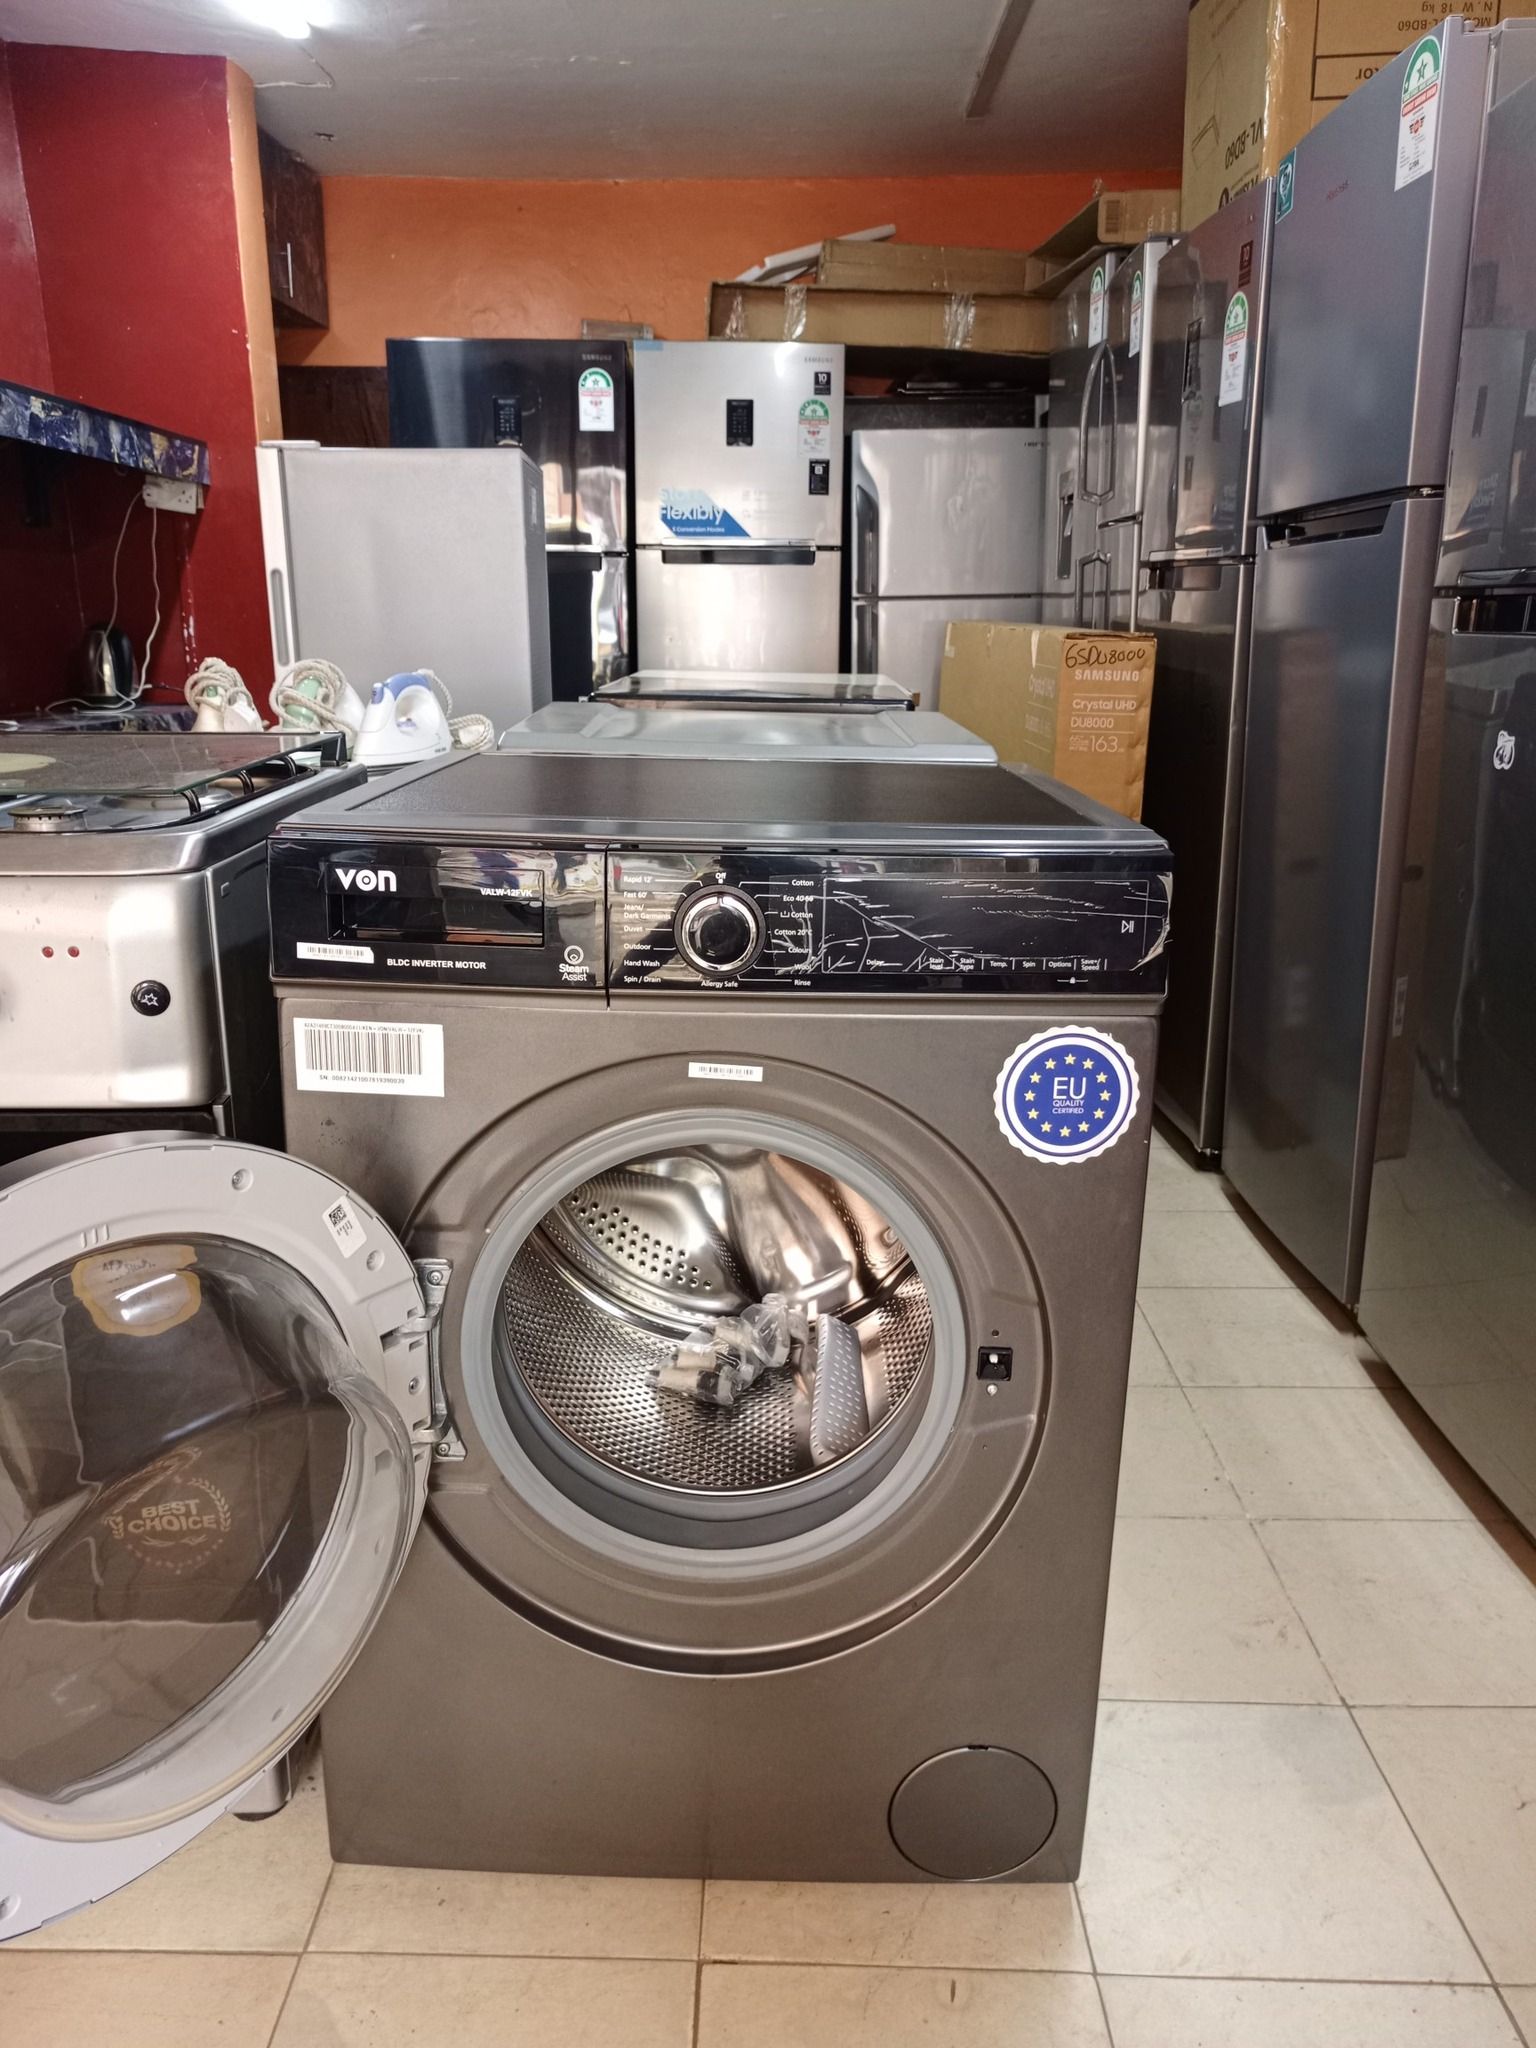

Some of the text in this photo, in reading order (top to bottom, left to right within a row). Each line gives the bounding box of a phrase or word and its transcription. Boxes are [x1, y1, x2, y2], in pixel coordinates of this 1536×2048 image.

[1421, 2, 1435, 14] kg
[1074, 669, 1140, 682] SAMSUNG
[1072, 698, 1137, 713] Crystal UHD
[1070, 716, 1114, 729] DU8000
[1091, 735, 1118, 753] 163
[623, 875, 643, 884] Rapid
[715, 872, 727, 880] Off
[791, 879, 814, 887] Cotton
[479, 887, 533, 898] VALW-12FVK
[640, 912, 672, 920] Garments
[791, 911, 813, 920] Cotton
[774, 929, 797, 937] Cotton
[387, 958, 487, 970] BLDC INVERTER MOTOR
[623, 959, 640, 967] Hand
[1022, 960, 1036, 969] Spin
[1048, 960, 1072, 969] Options
[558, 963, 589, 973] Steam
[562, 972, 588, 982] Assist
[623, 975, 638, 984] Spin
[701, 980, 723, 989] Allergy
[1052, 1076, 1087, 1100] EU
[1052, 1099, 1085, 1107] QUALITY
[141, 1499, 200, 1518] BEST
[127, 1514, 218, 1534] CHOICE
